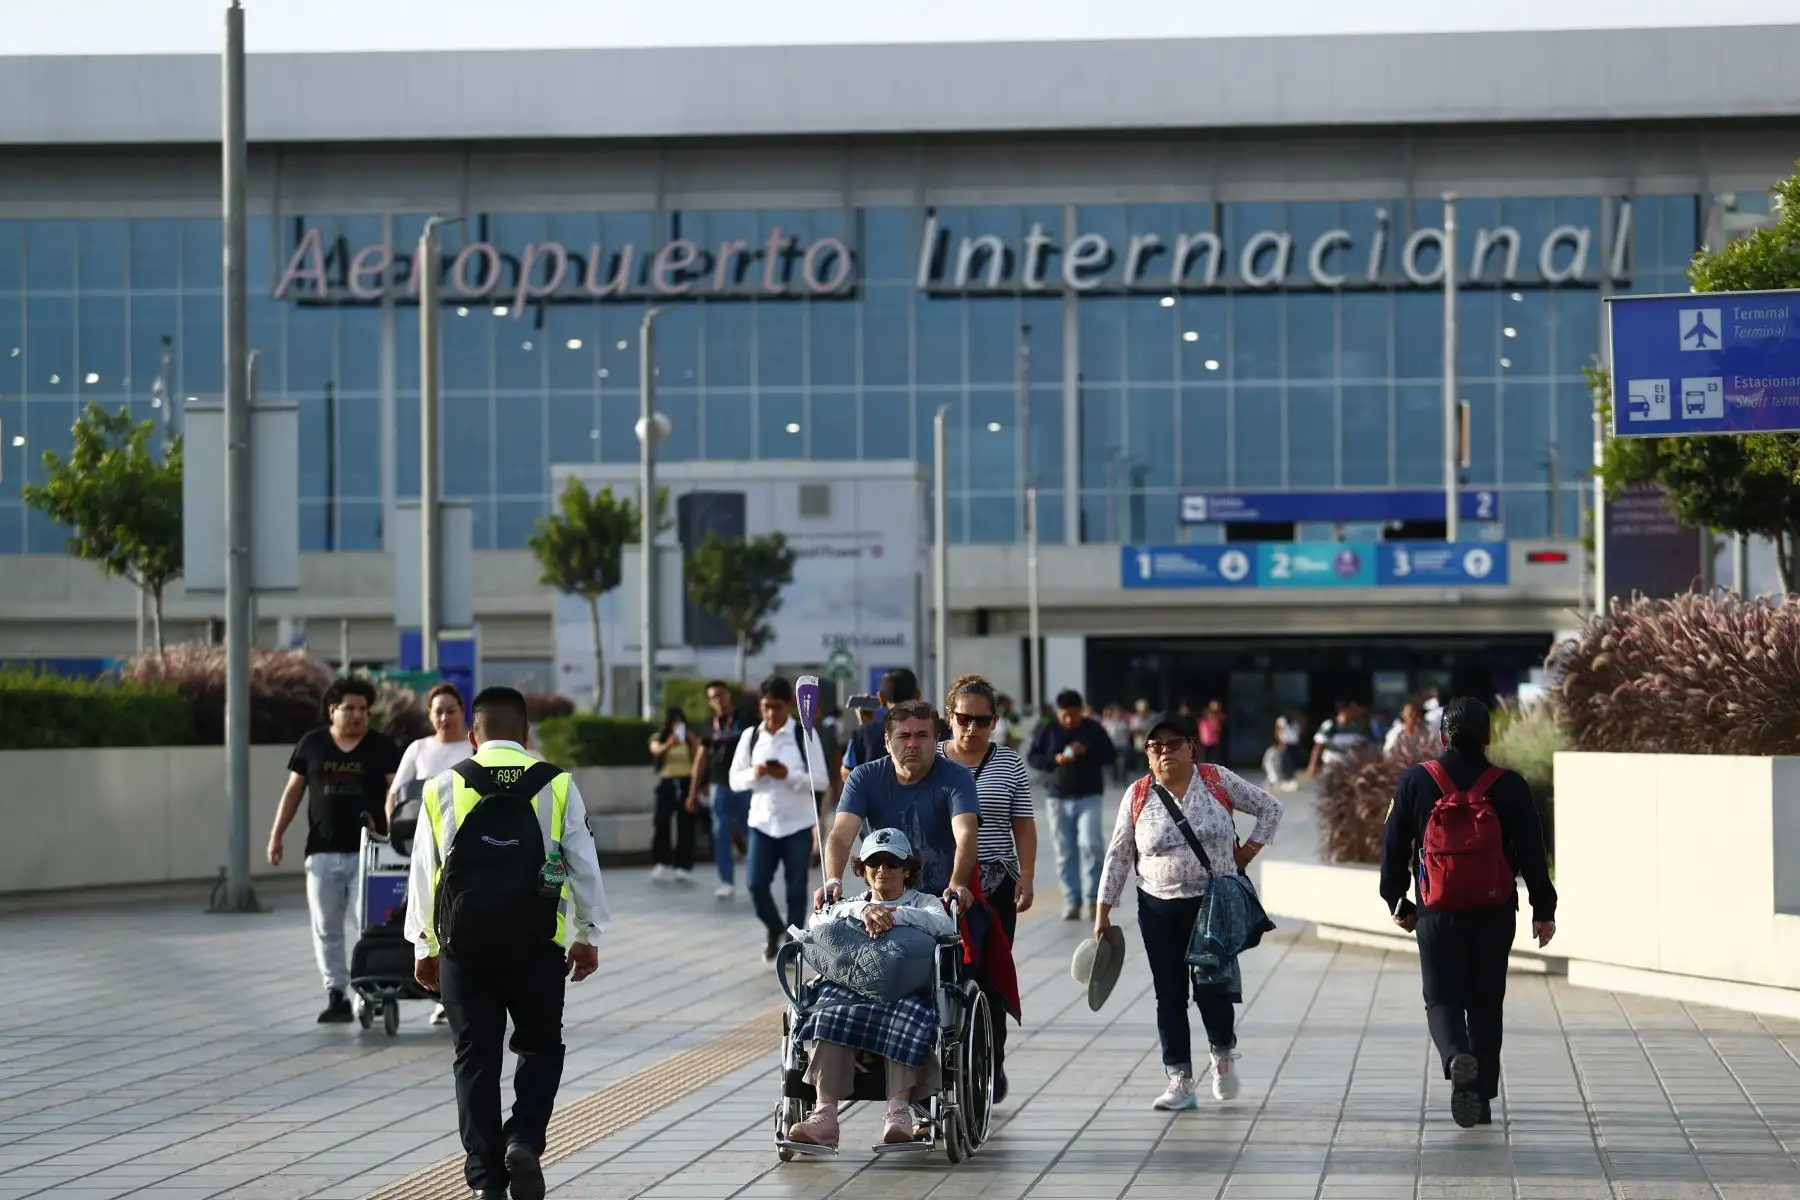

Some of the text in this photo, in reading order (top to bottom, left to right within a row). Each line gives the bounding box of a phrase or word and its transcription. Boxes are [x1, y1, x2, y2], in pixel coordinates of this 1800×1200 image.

[275, 197, 1632, 319] Aeropuerto Internacional
[1732, 304, 1788, 320] Terminal
[1733, 322, 1786, 338] Terminal
[1654, 383, 1664, 393] E1
[1707, 382, 1718, 392] E3
[1654, 394, 1665, 404] E2
[1735, 393, 1768, 408] Short
[1476, 493, 1492, 518] 2
[1137, 551, 1151, 579] 1
[1270, 551, 1291, 578] 2
[1393, 549, 1411, 577] 3
